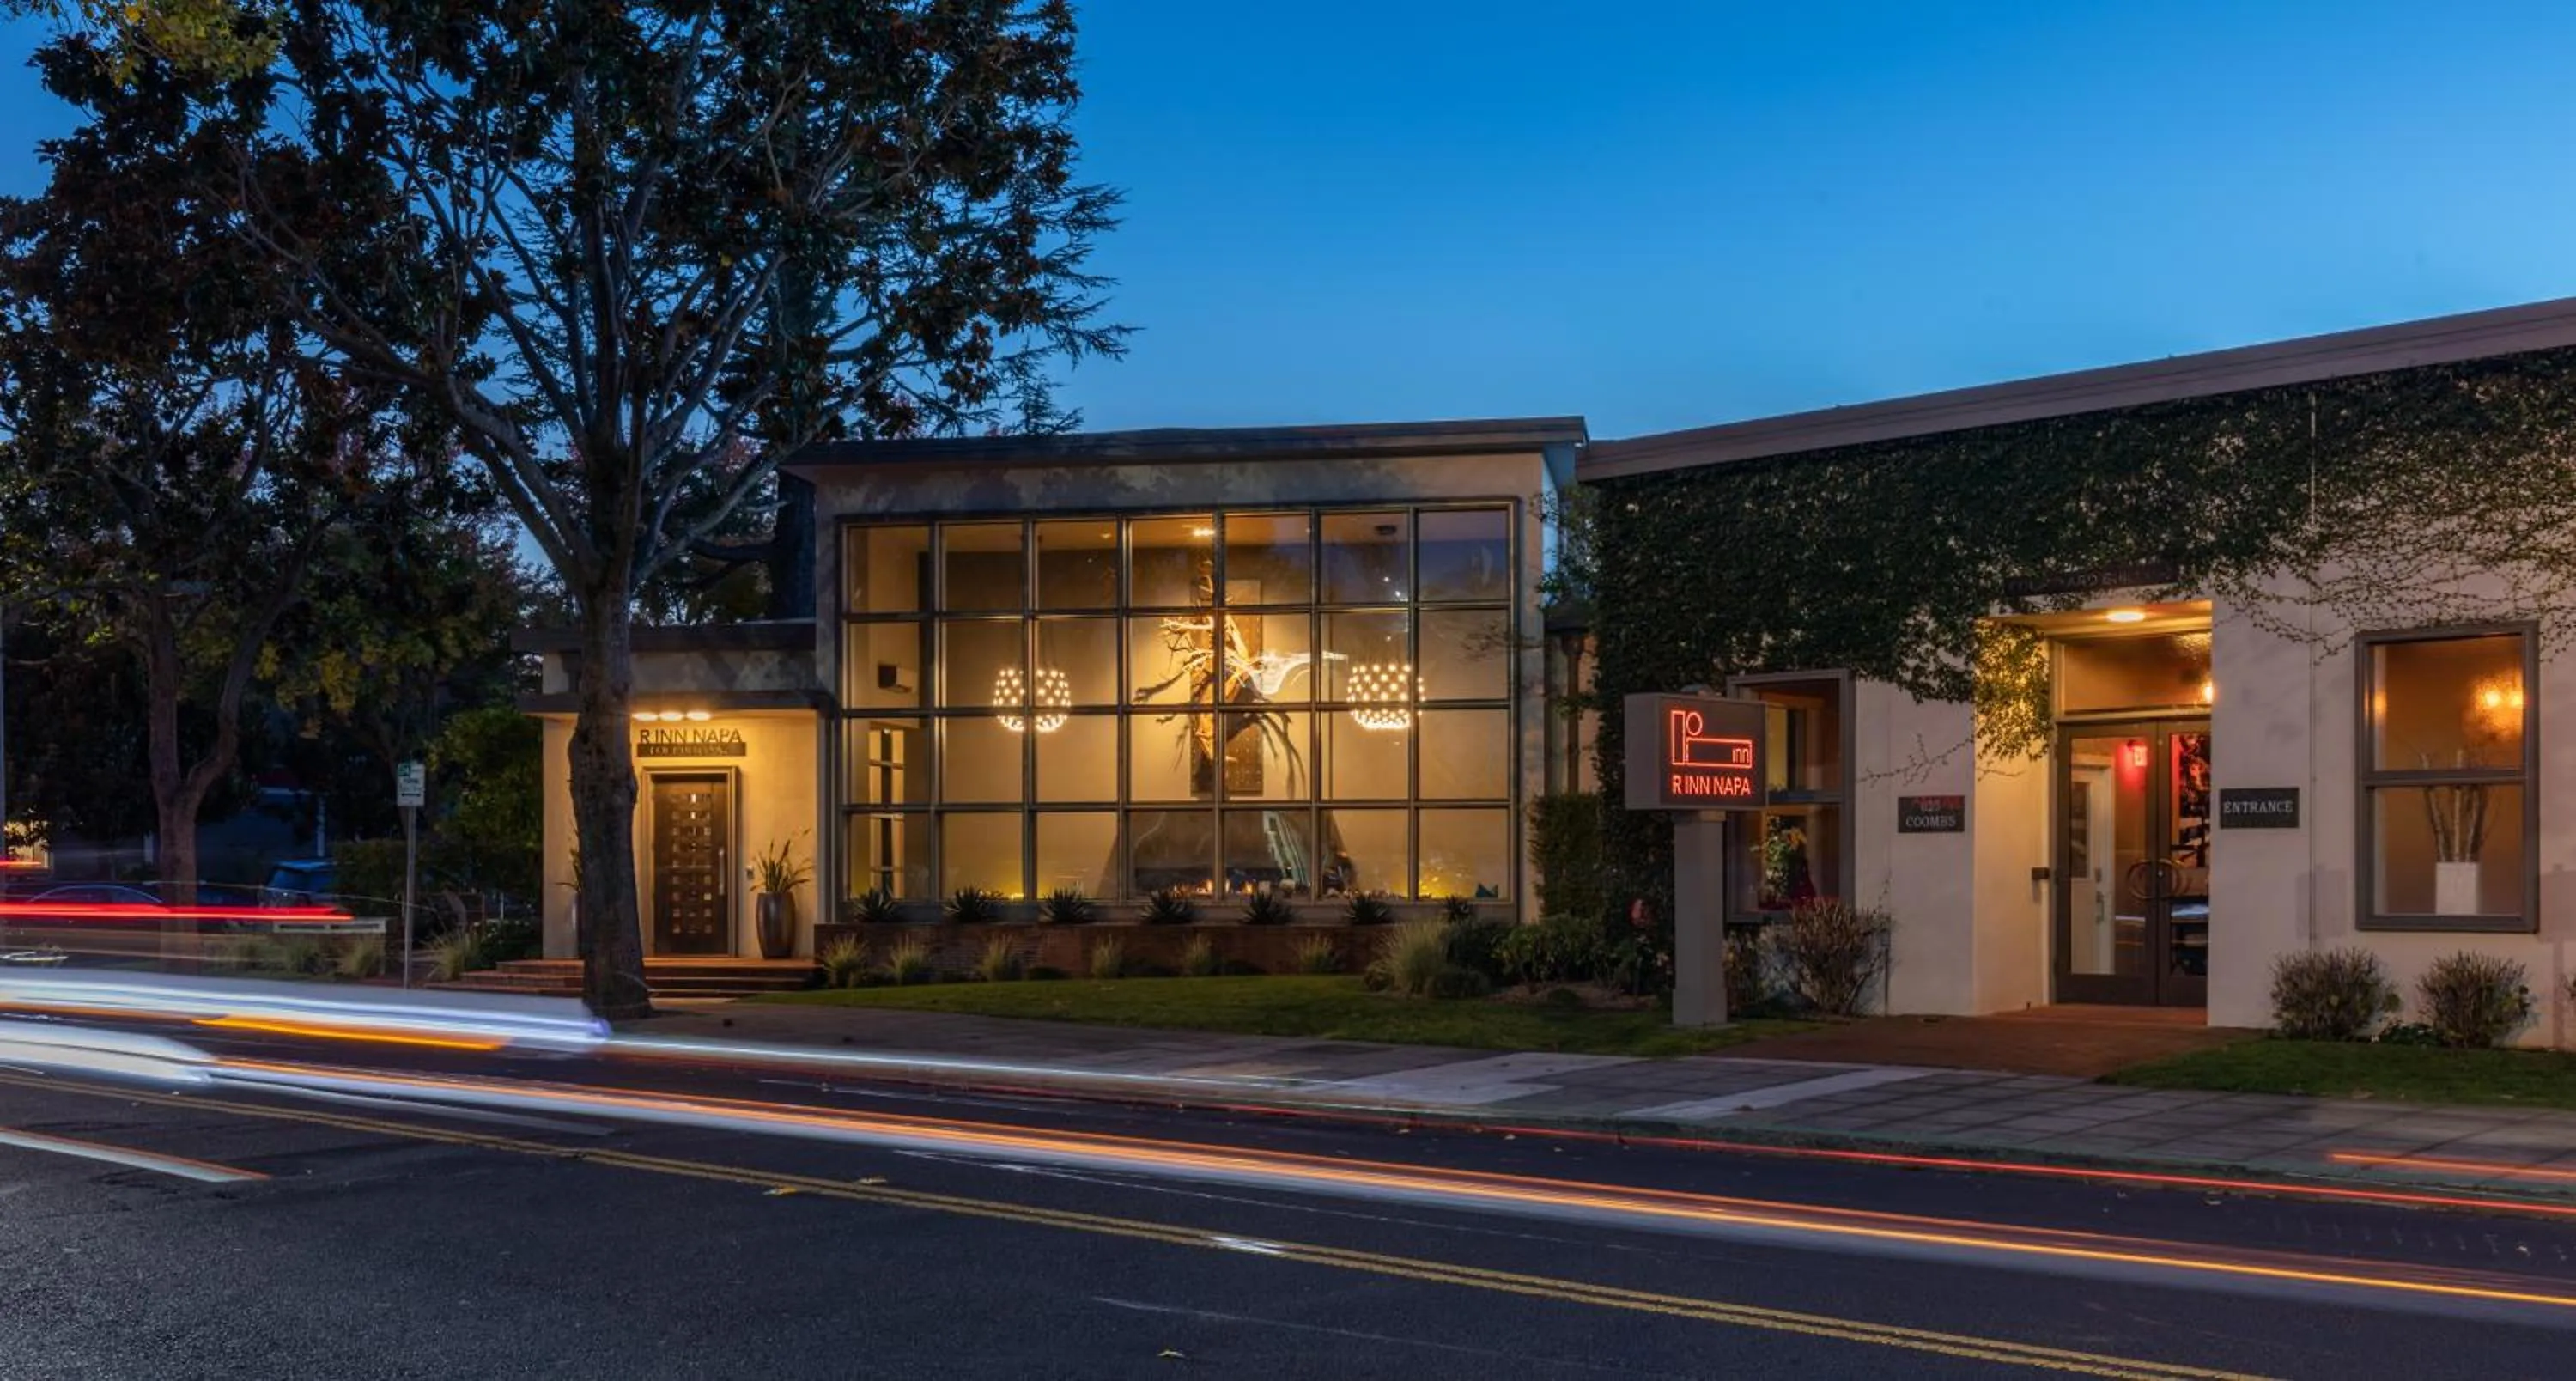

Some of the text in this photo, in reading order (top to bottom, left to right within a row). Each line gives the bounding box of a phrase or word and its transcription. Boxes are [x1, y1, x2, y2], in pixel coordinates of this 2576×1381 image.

[640, 728, 742, 743] R INN NAPA
[1673, 775, 1752, 797] R INN NAPA
[2223, 800, 2293, 814] ENTRANCE
[1905, 815, 1957, 828] COOMBS
